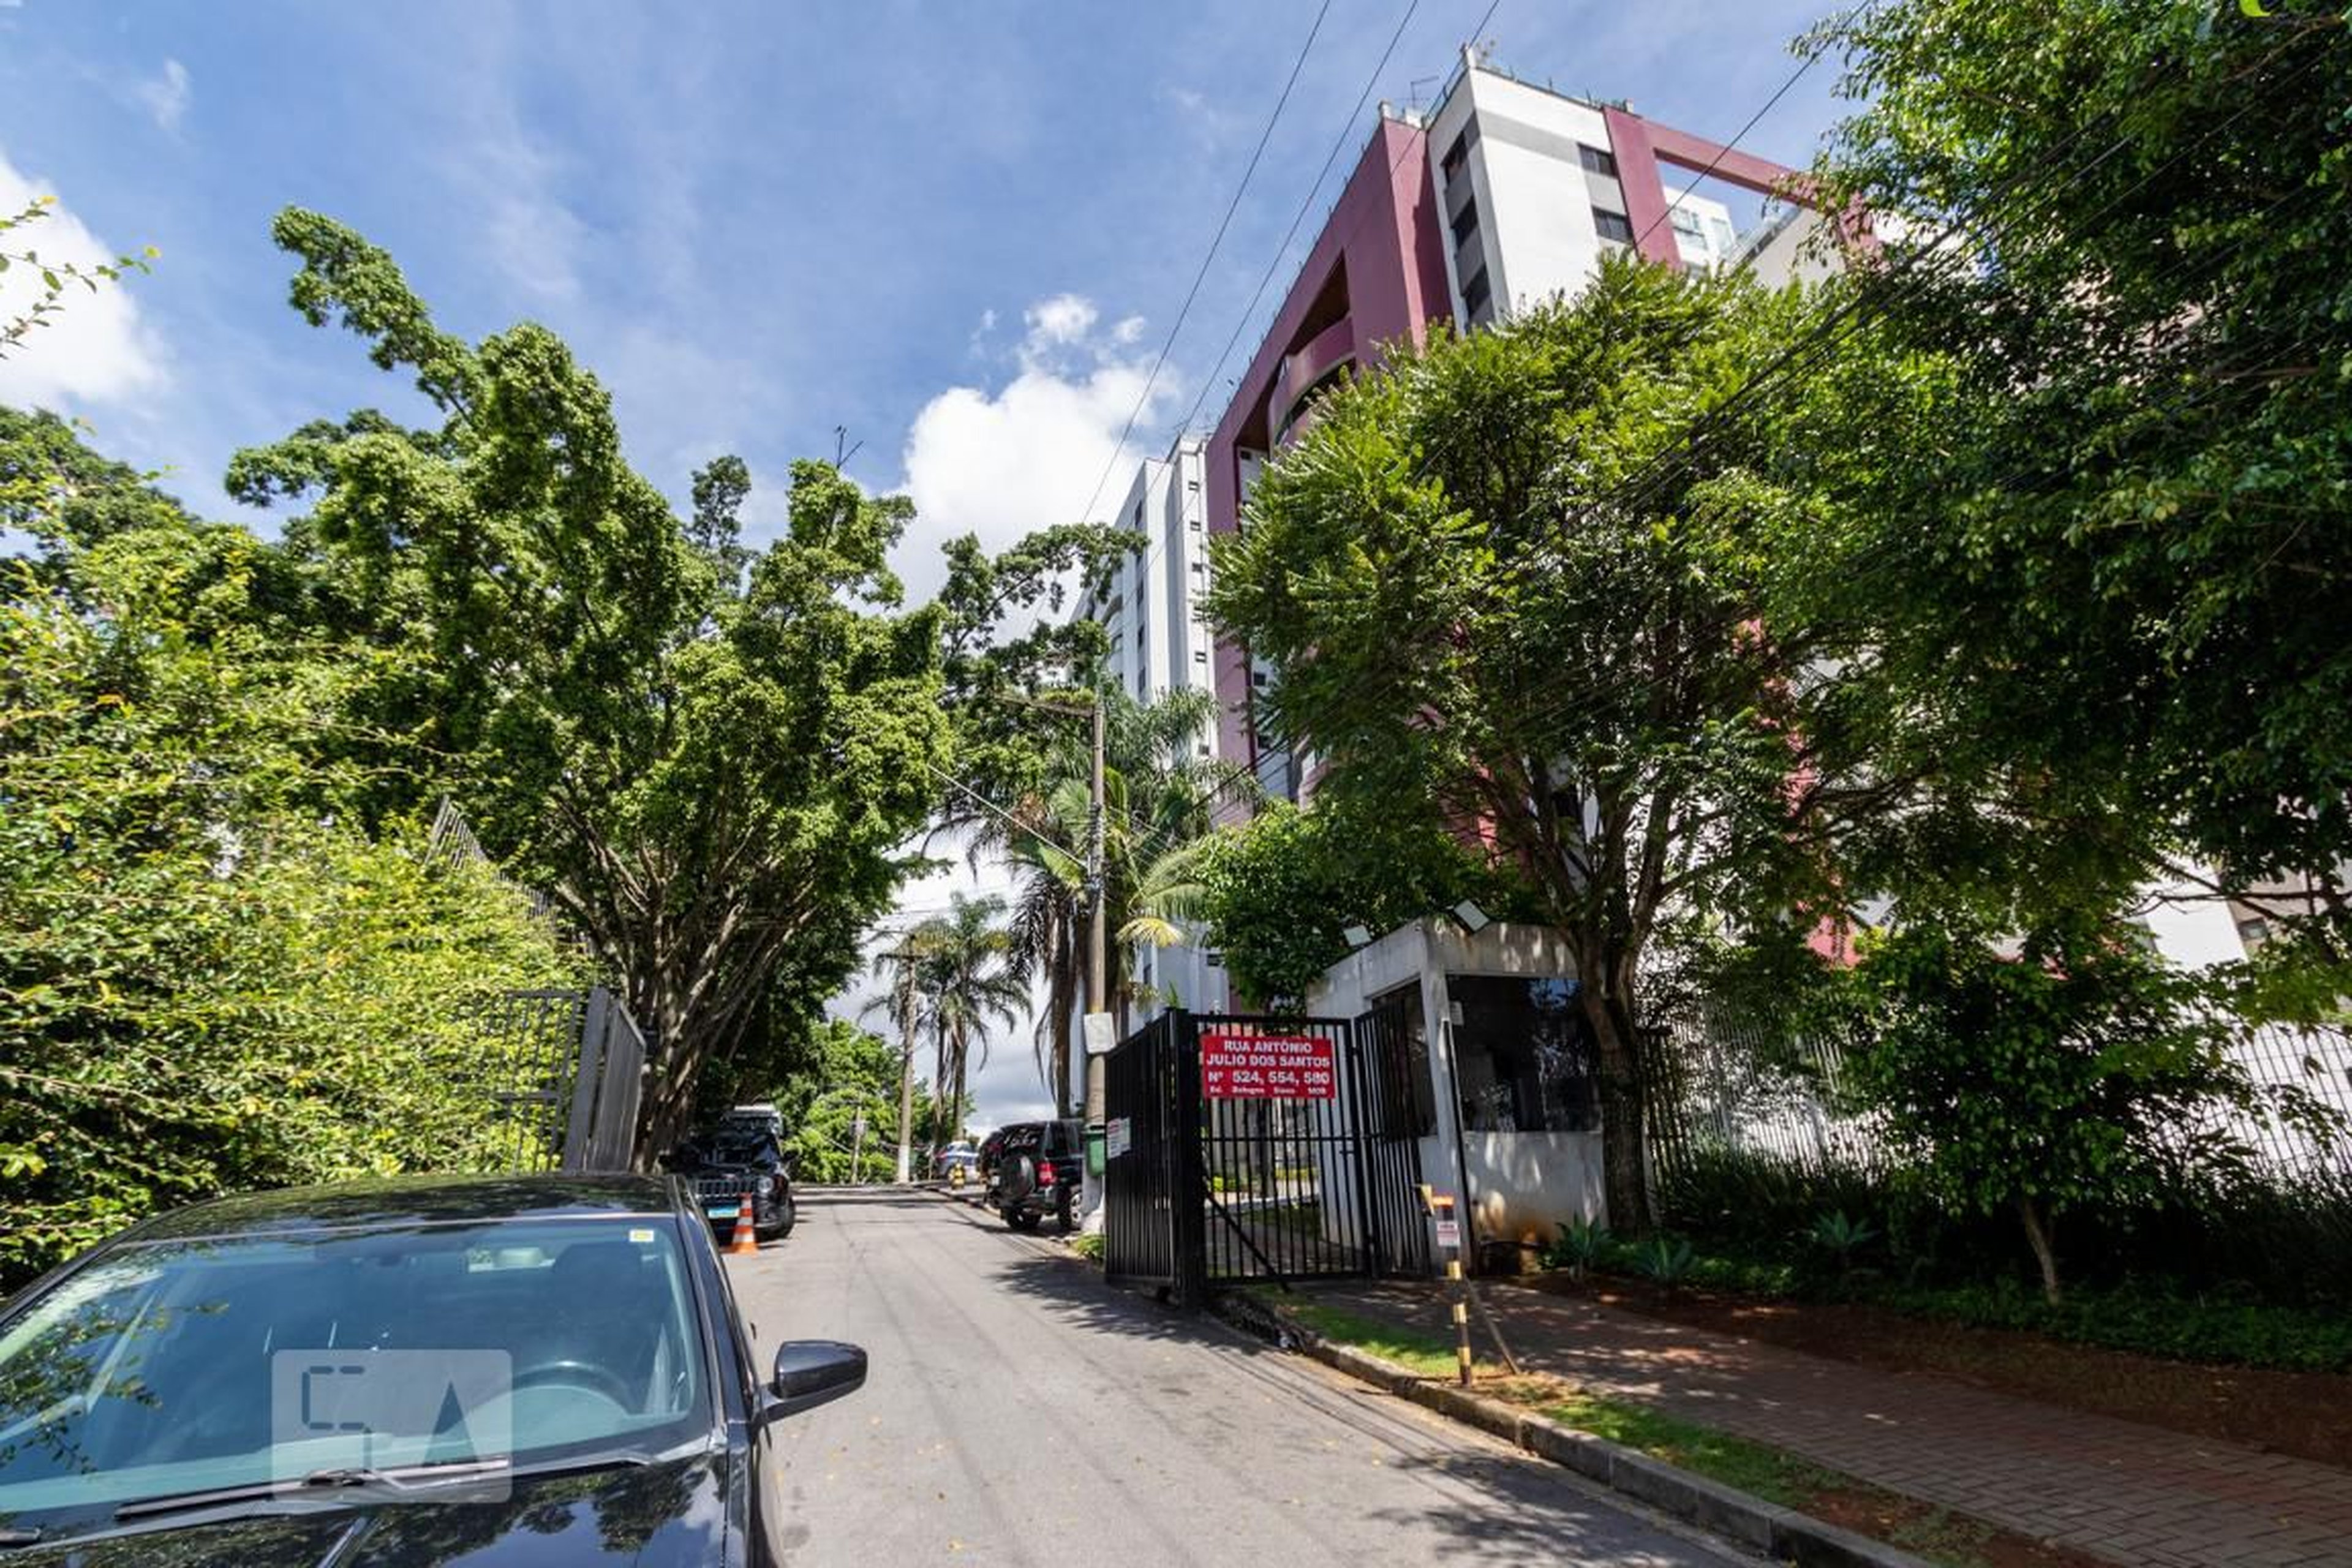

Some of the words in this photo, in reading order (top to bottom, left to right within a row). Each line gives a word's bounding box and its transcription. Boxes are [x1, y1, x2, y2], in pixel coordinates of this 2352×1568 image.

[1224, 1040, 1250, 1052] RUA
[1207, 1054, 1246, 1066] JULIO
[1249, 1055, 1276, 1067] DOS
[1280, 1056, 1330, 1068] SANTOS
